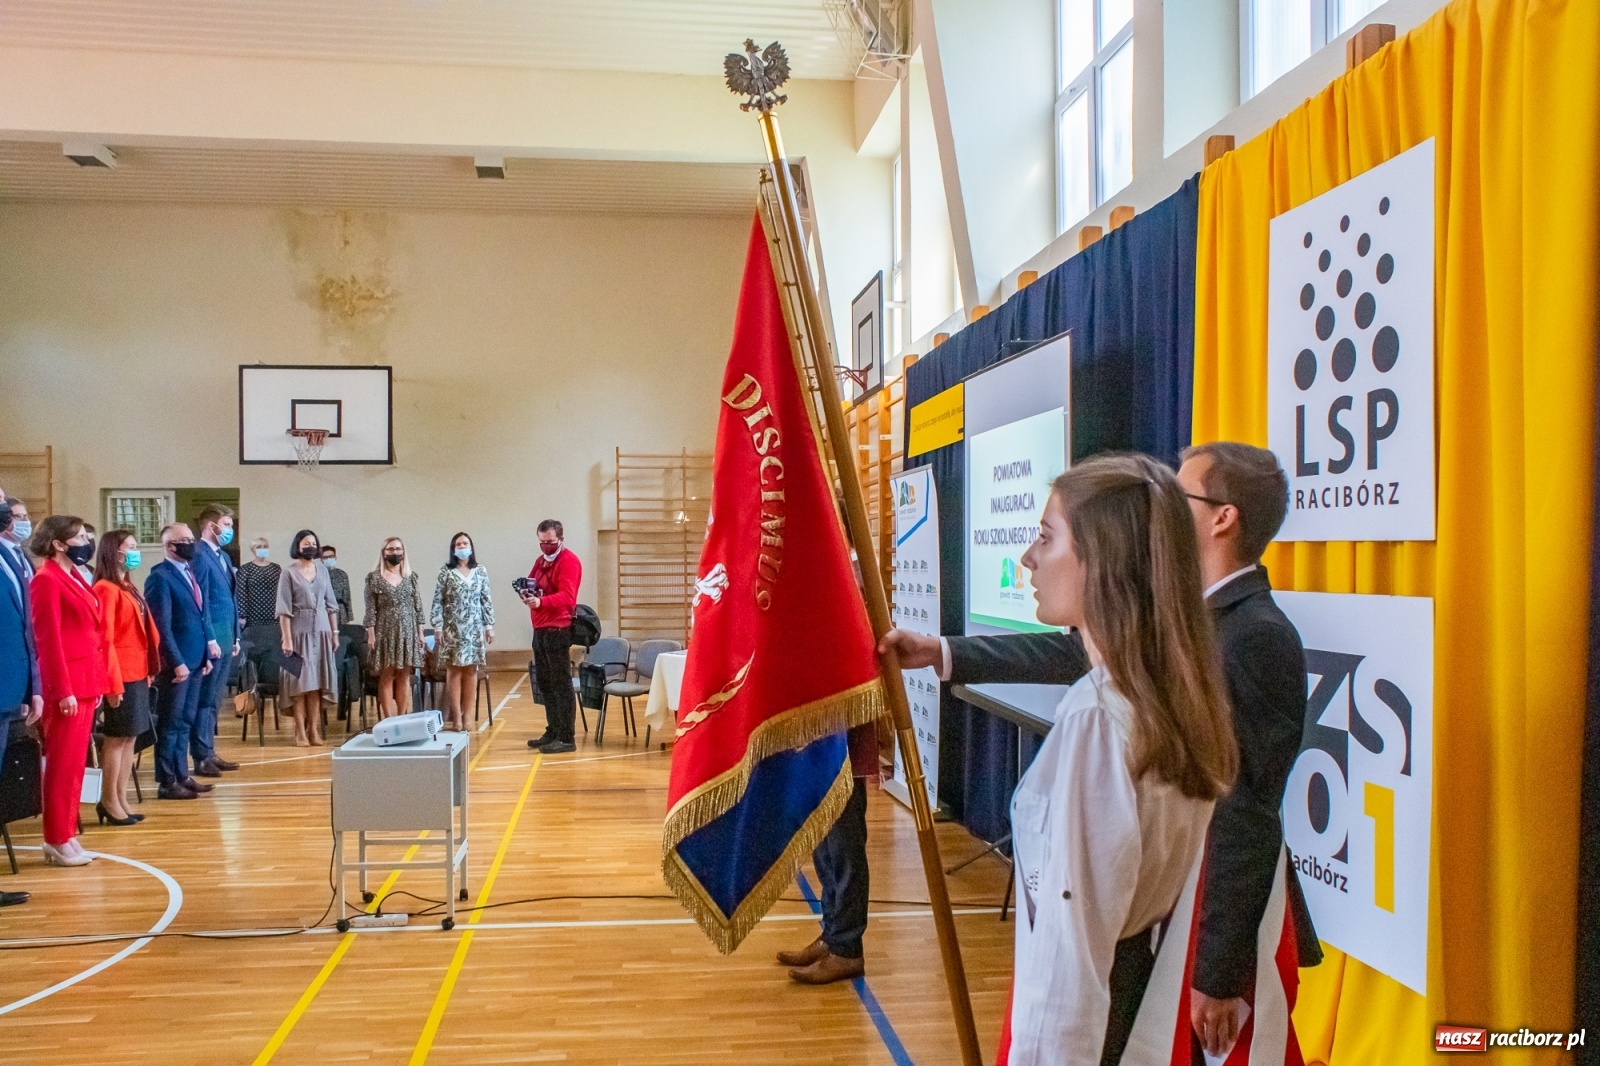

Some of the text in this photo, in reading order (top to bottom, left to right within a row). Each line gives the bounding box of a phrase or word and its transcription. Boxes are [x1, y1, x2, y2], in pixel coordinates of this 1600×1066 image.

[1295, 388, 1399, 477] LSP
[993, 459, 1032, 481] POWIATOWA
[990, 492, 1035, 513] INAUGURACJA
[1296, 479, 1399, 509] RACIBÓRZ
[974, 529, 989, 545] ROKU
[990, 526, 1028, 545] SZKOLNEGO
[1292, 854, 1348, 893] acibórz
